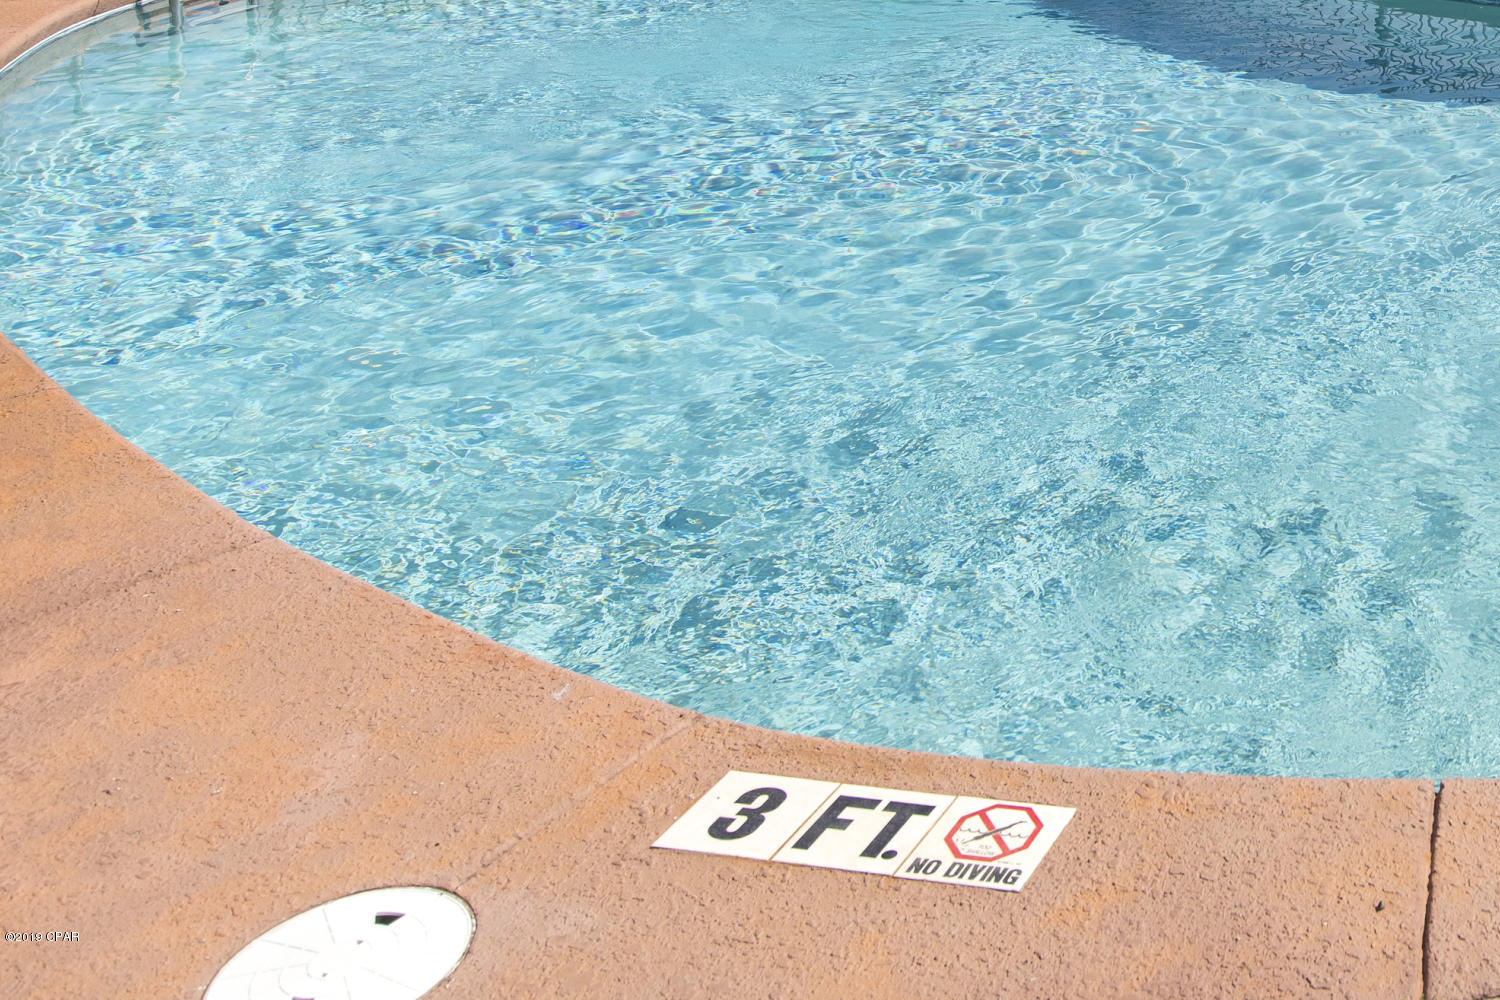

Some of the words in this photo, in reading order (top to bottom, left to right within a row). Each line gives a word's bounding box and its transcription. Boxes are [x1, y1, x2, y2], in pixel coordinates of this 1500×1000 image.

[707, 786, 788, 841] 3
[790, 794, 937, 861] FT.
[905, 857, 943, 876] NO
[942, 861, 1023, 886] DIVING
